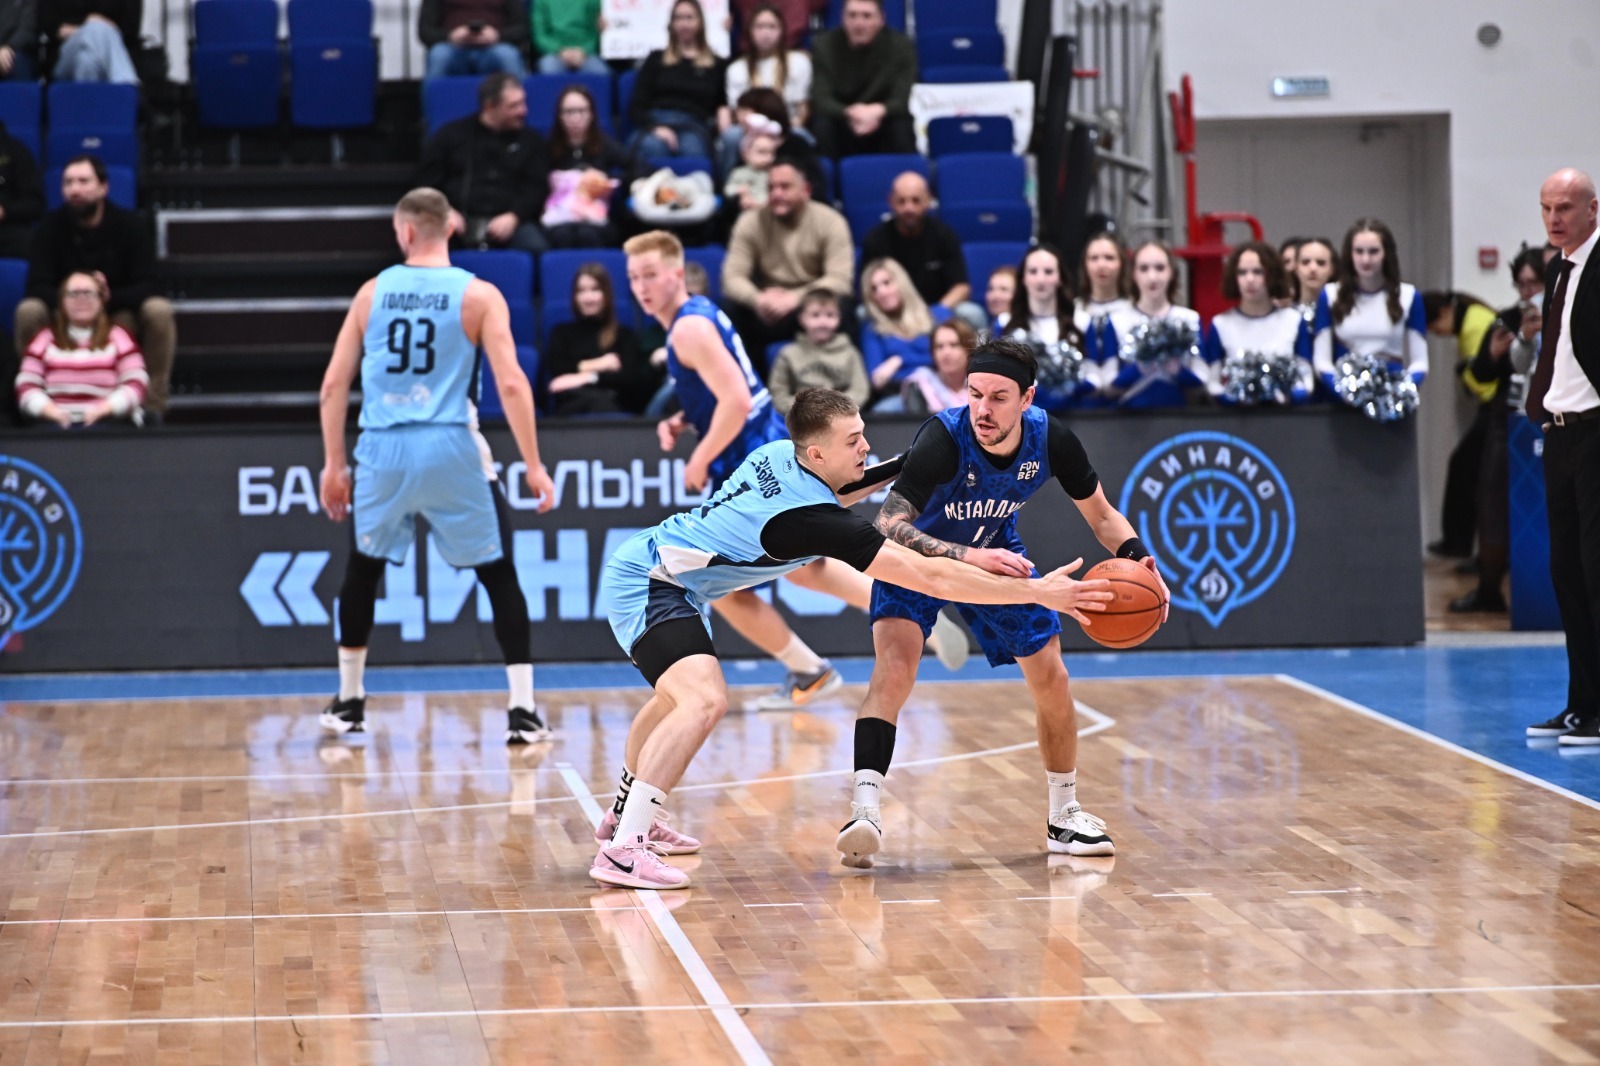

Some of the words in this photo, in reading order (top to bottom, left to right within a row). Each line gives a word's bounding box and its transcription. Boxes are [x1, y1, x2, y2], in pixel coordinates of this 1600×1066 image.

[385, 317, 435, 374] 93
[1017, 470, 1038, 481] BET
[1019, 461, 1040, 471] FON
[1141, 445, 1276, 501] ДИНАМО
